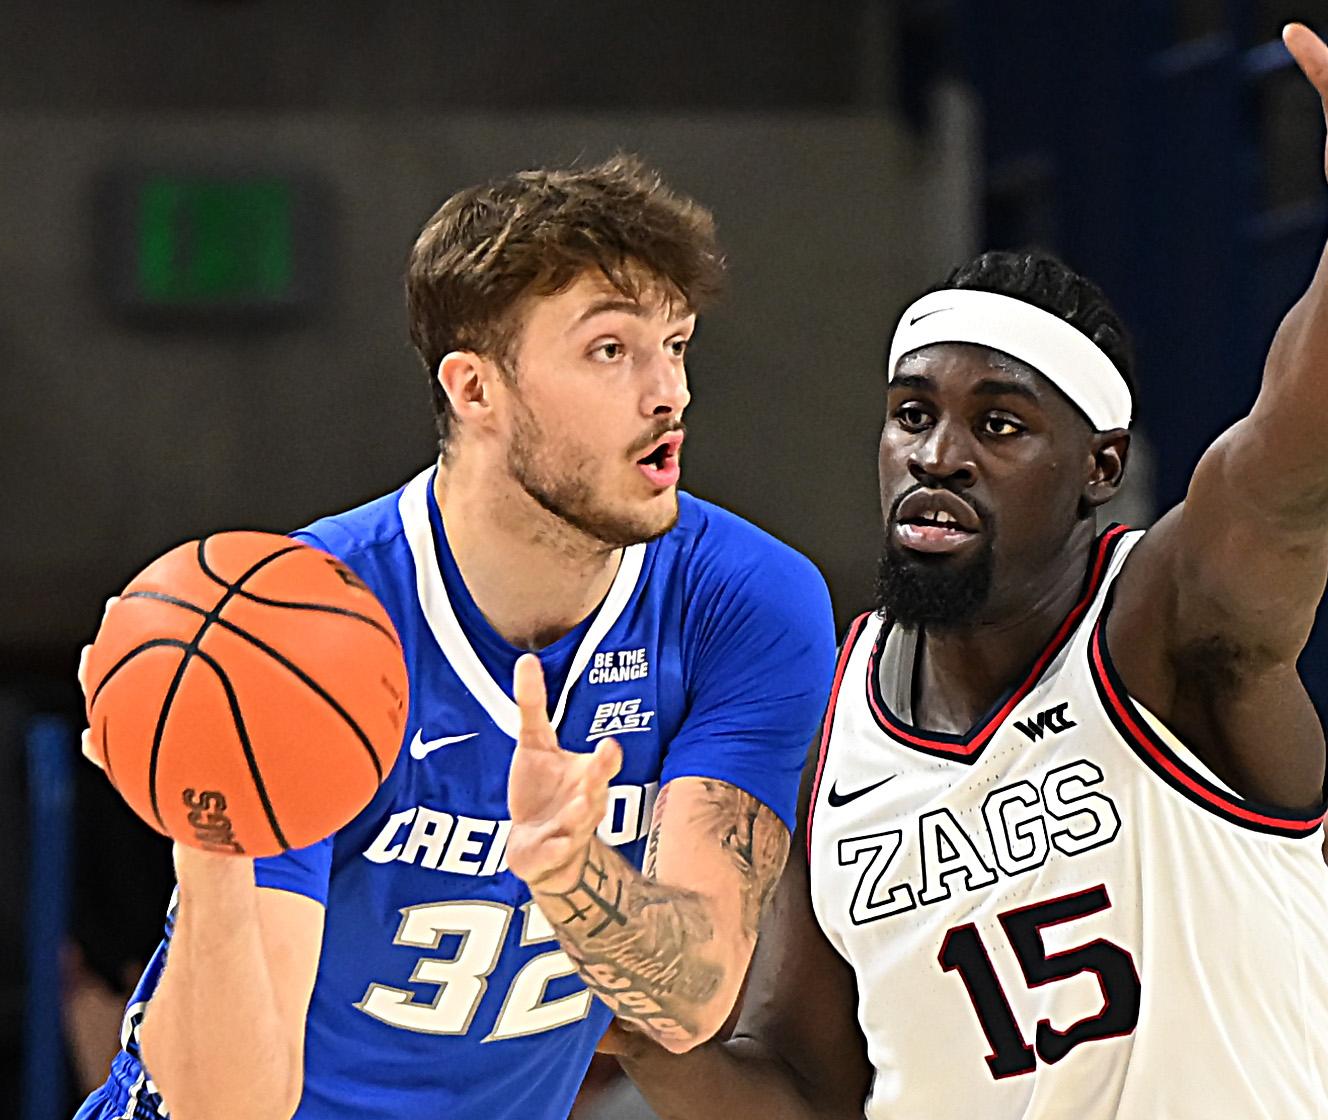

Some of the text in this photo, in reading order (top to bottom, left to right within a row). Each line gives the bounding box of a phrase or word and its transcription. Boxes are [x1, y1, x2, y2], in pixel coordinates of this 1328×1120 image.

[588, 661, 649, 685] CHANGE
[594, 648, 646, 668] BE THE
[589, 710, 655, 734] EAST
[594, 698, 642, 720] BIG
[362, 781, 660, 878] CREIO
[837, 757, 1122, 926] ZAGS
[352, 898, 594, 1044] 32
[937, 882, 1142, 1081] 15
